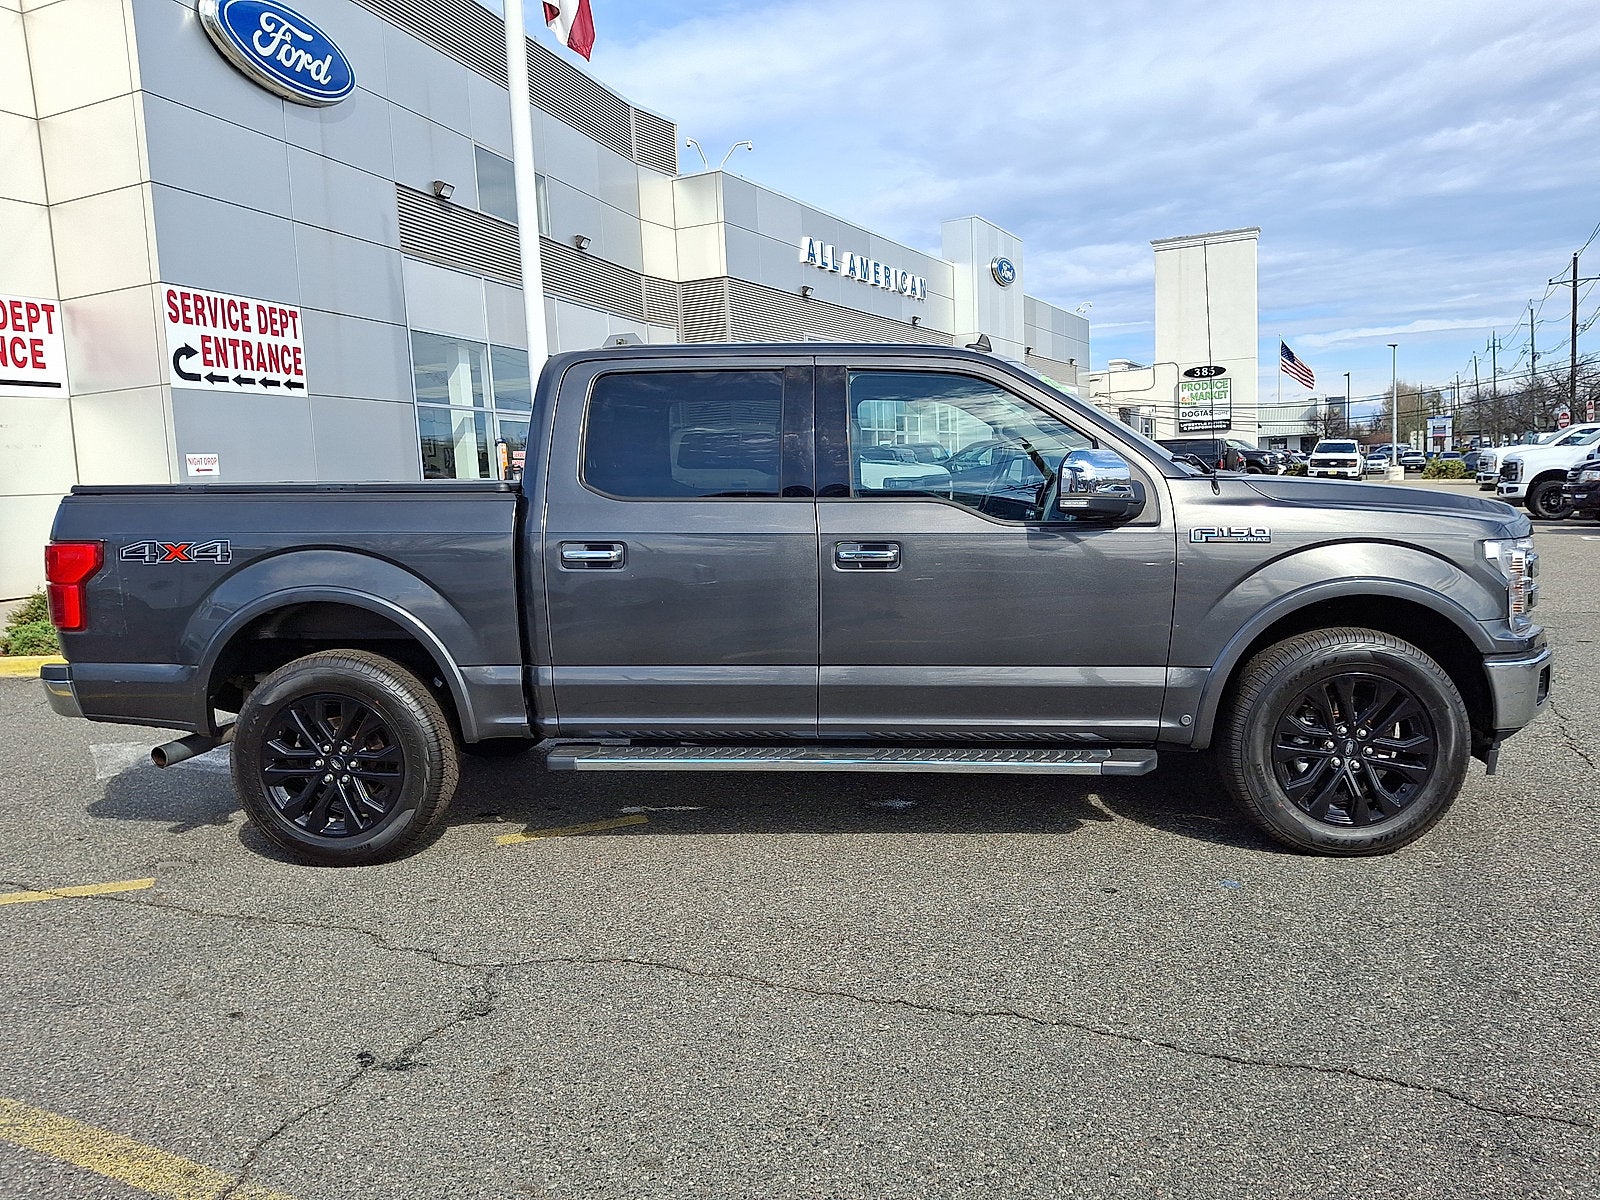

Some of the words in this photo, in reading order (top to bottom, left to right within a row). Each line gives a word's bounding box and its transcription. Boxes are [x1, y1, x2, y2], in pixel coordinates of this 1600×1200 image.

[253, 12, 333, 85] Ford
[803, 237, 839, 271] ALL
[844, 252, 927, 299] AMERICAN
[167, 289, 251, 332] SERVICE
[256, 304, 298, 339] DEPT
[201, 335, 303, 376] ENTRANCE
[1194, 367, 1215, 376] 385
[1181, 380, 1228, 392] PRODUCE
[1190, 390, 1228, 401] MARKET
